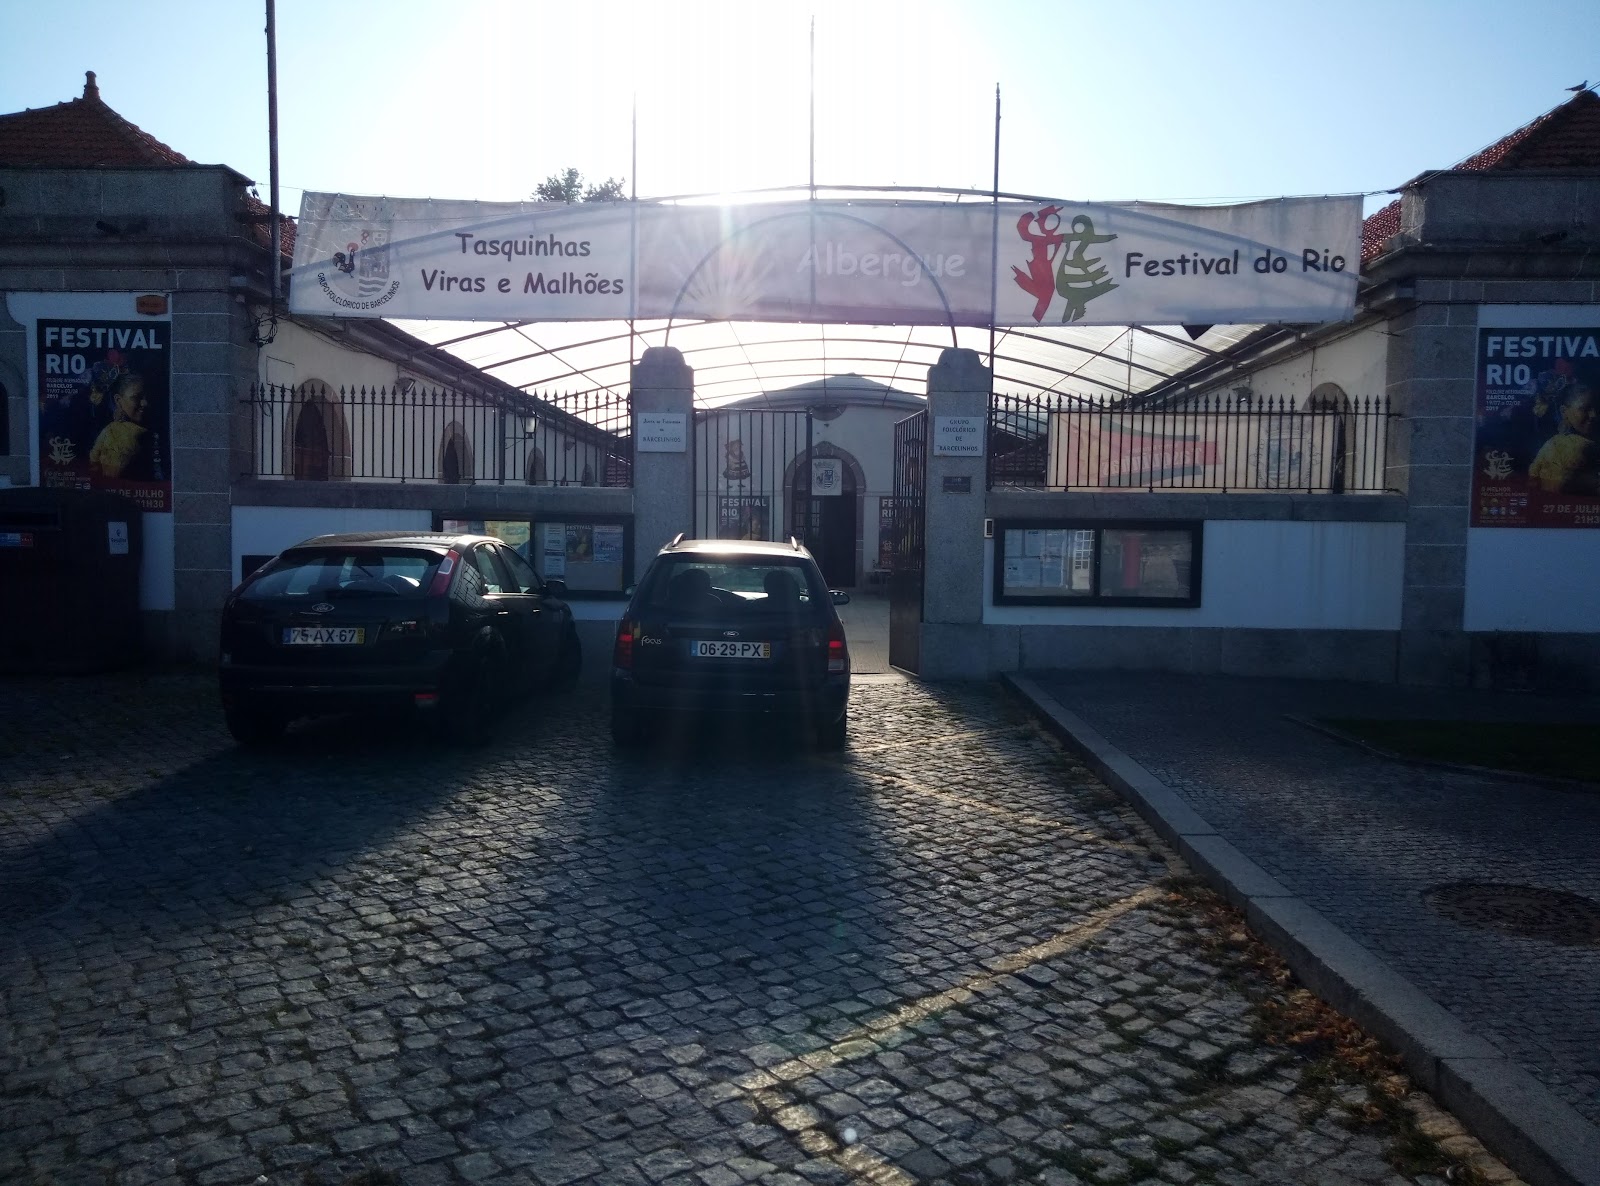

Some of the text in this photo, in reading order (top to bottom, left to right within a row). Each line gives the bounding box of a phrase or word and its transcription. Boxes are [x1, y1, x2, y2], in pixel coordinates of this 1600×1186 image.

[454, 232, 591, 262] Tasquinhas
[796, 241, 966, 287] Albergue
[1125, 248, 1346, 278] Festival do Rio
[317, 272, 330, 293] GRUPO
[361, 302, 370, 310] DE
[370, 280, 401, 309] BARCELINHOS
[421, 268, 625, 295] Viras e Malhões
[45, 326, 163, 350] FESTIVAL
[45, 353, 86, 375] RIO
[1486, 363, 1531, 386] RIO
[942, 425, 977, 433] FOLCLÓRICO
[133, 489, 164, 498] JULHO
[721, 498, 767, 507] FESTIVAL
[721, 508, 738, 517] RIO
[1542, 504, 1556, 513] 27
[1557, 504, 1571, 513] DE
